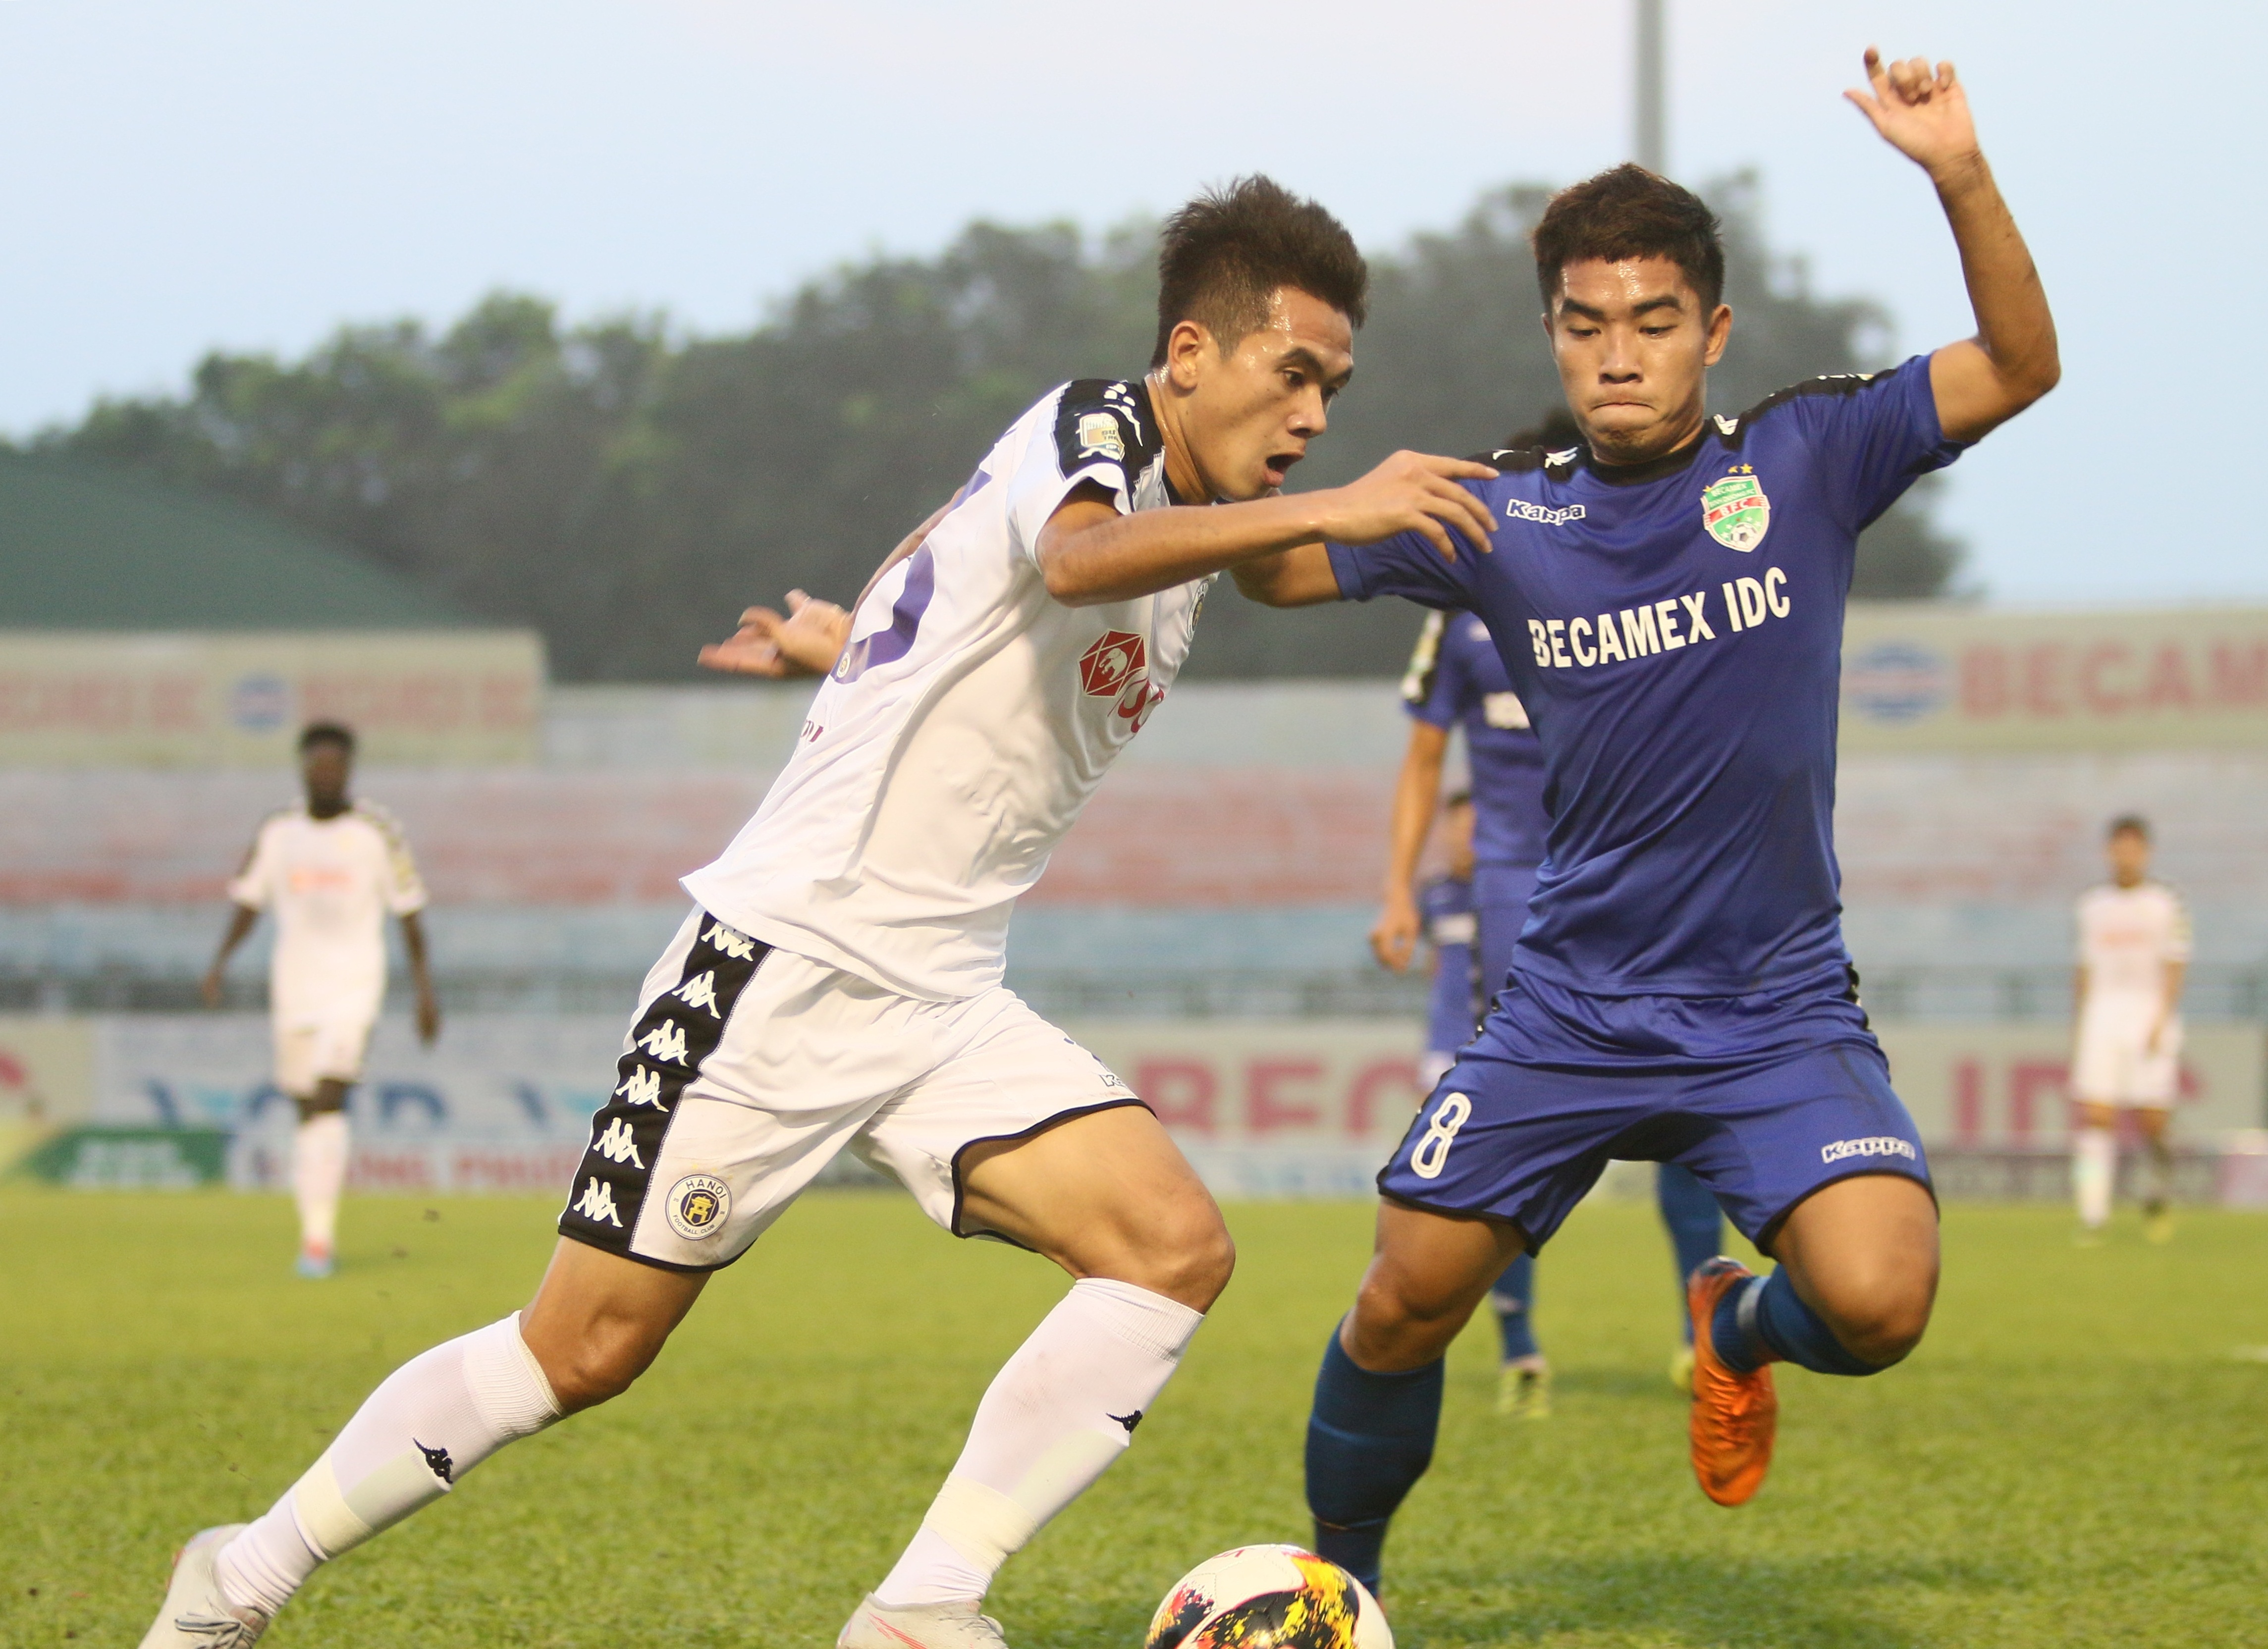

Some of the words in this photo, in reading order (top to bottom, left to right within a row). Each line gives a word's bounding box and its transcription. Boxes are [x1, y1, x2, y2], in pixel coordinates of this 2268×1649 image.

[1507, 498, 1586, 526] Kappa
[1528, 591, 1716, 668] BECAMEX
[1722, 567, 1790, 632] IDC
[1410, 1092, 1472, 1179] 8
[1821, 1136, 1916, 1164] Kappa
[686, 1179, 727, 1199] HANOI
[673, 1215, 698, 1234] FOOTBALL
[701, 1224, 715, 1234] CLUB
